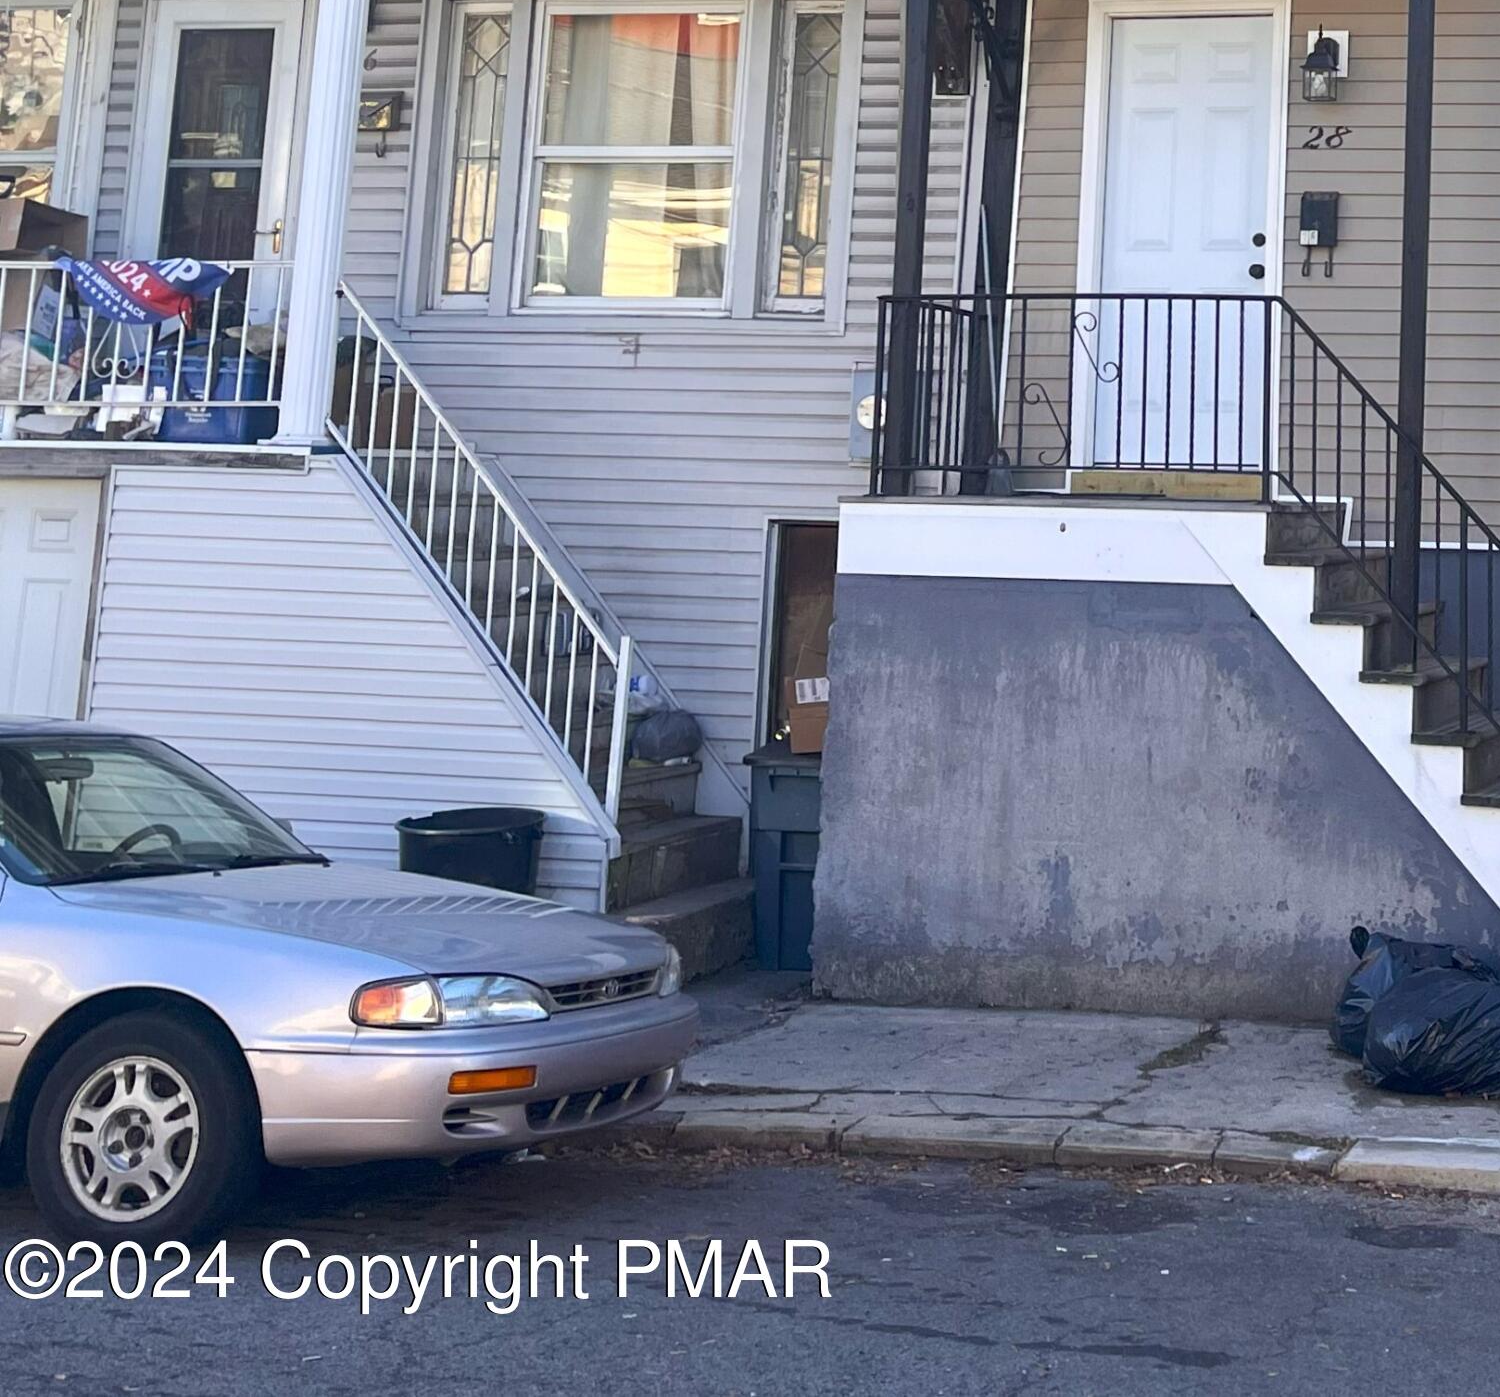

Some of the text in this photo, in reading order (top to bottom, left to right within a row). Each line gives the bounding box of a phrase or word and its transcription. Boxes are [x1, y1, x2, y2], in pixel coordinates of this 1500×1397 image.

[1302, 126, 1352, 150] 28
[90, 272, 122, 304] AMERICA
[122, 299, 147, 321] BACK
